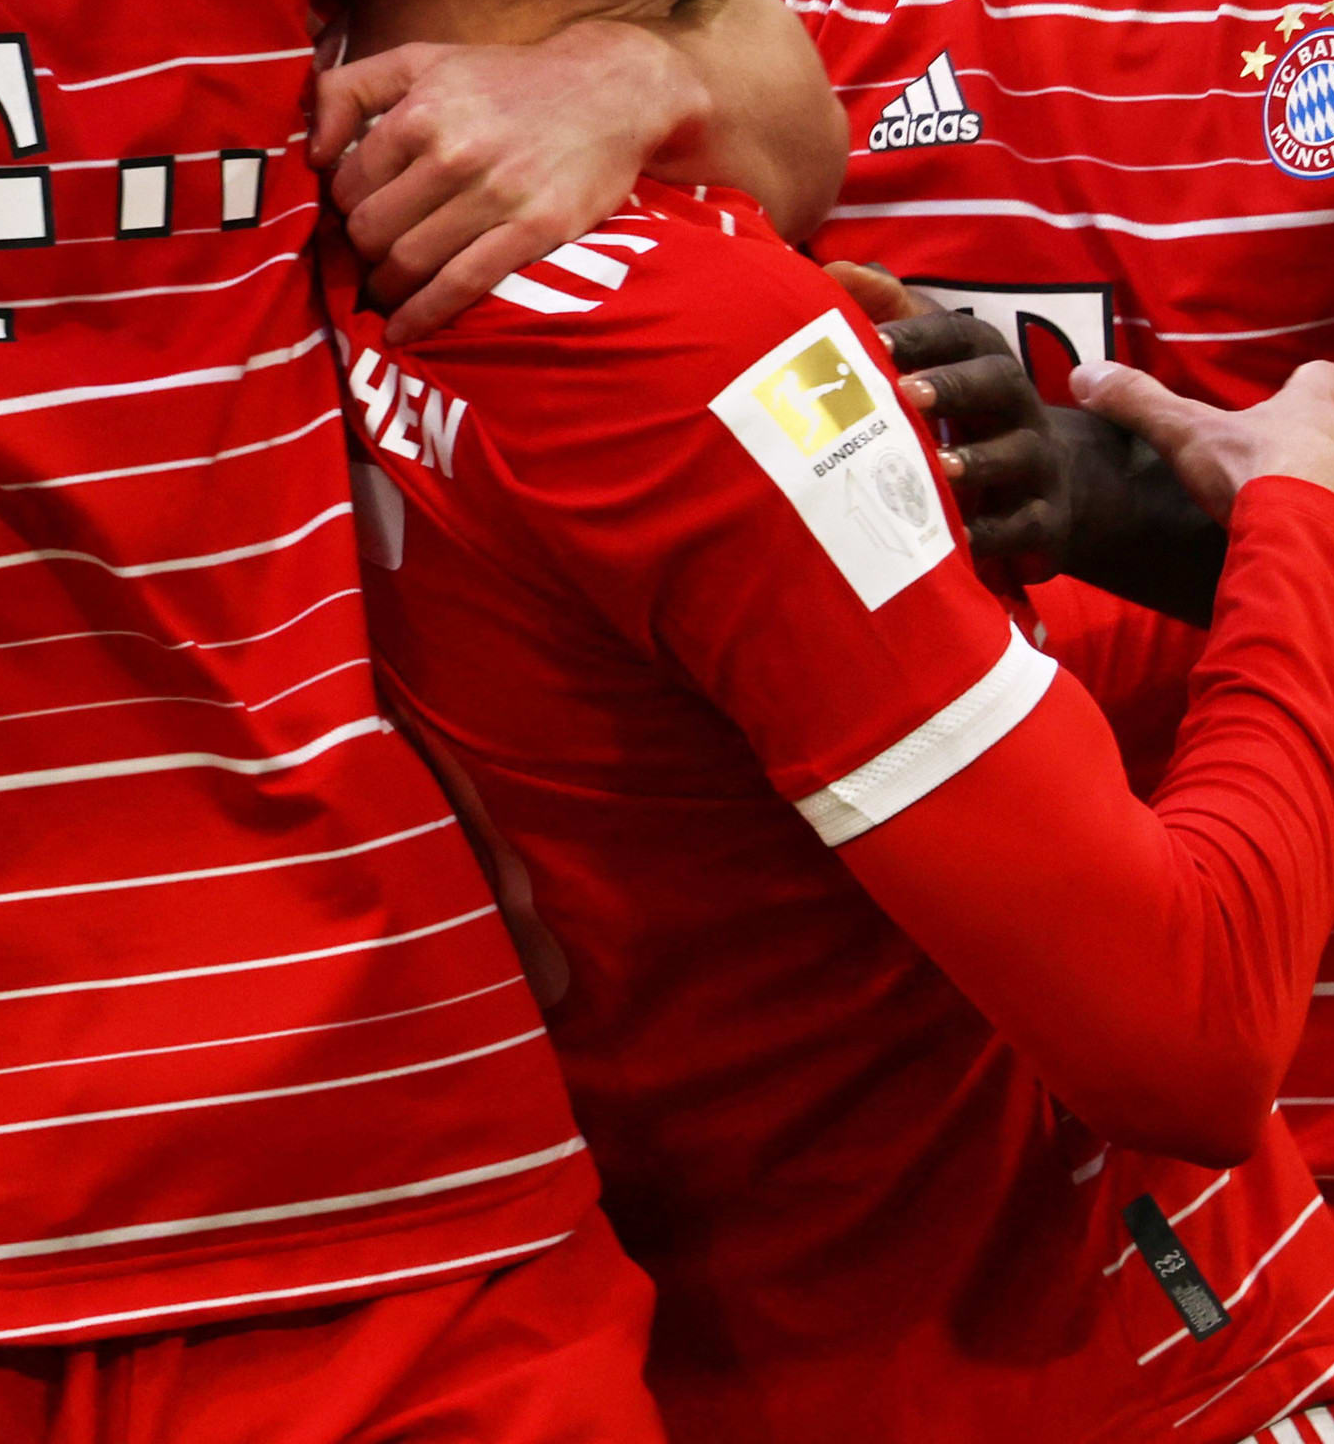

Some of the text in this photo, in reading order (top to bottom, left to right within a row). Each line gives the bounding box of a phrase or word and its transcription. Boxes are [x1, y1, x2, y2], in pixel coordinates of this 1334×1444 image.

[1272, 64, 1297, 100] FC
[868, 111, 981, 151] adidas
[812, 419, 890, 478] BUNDESLIGA
